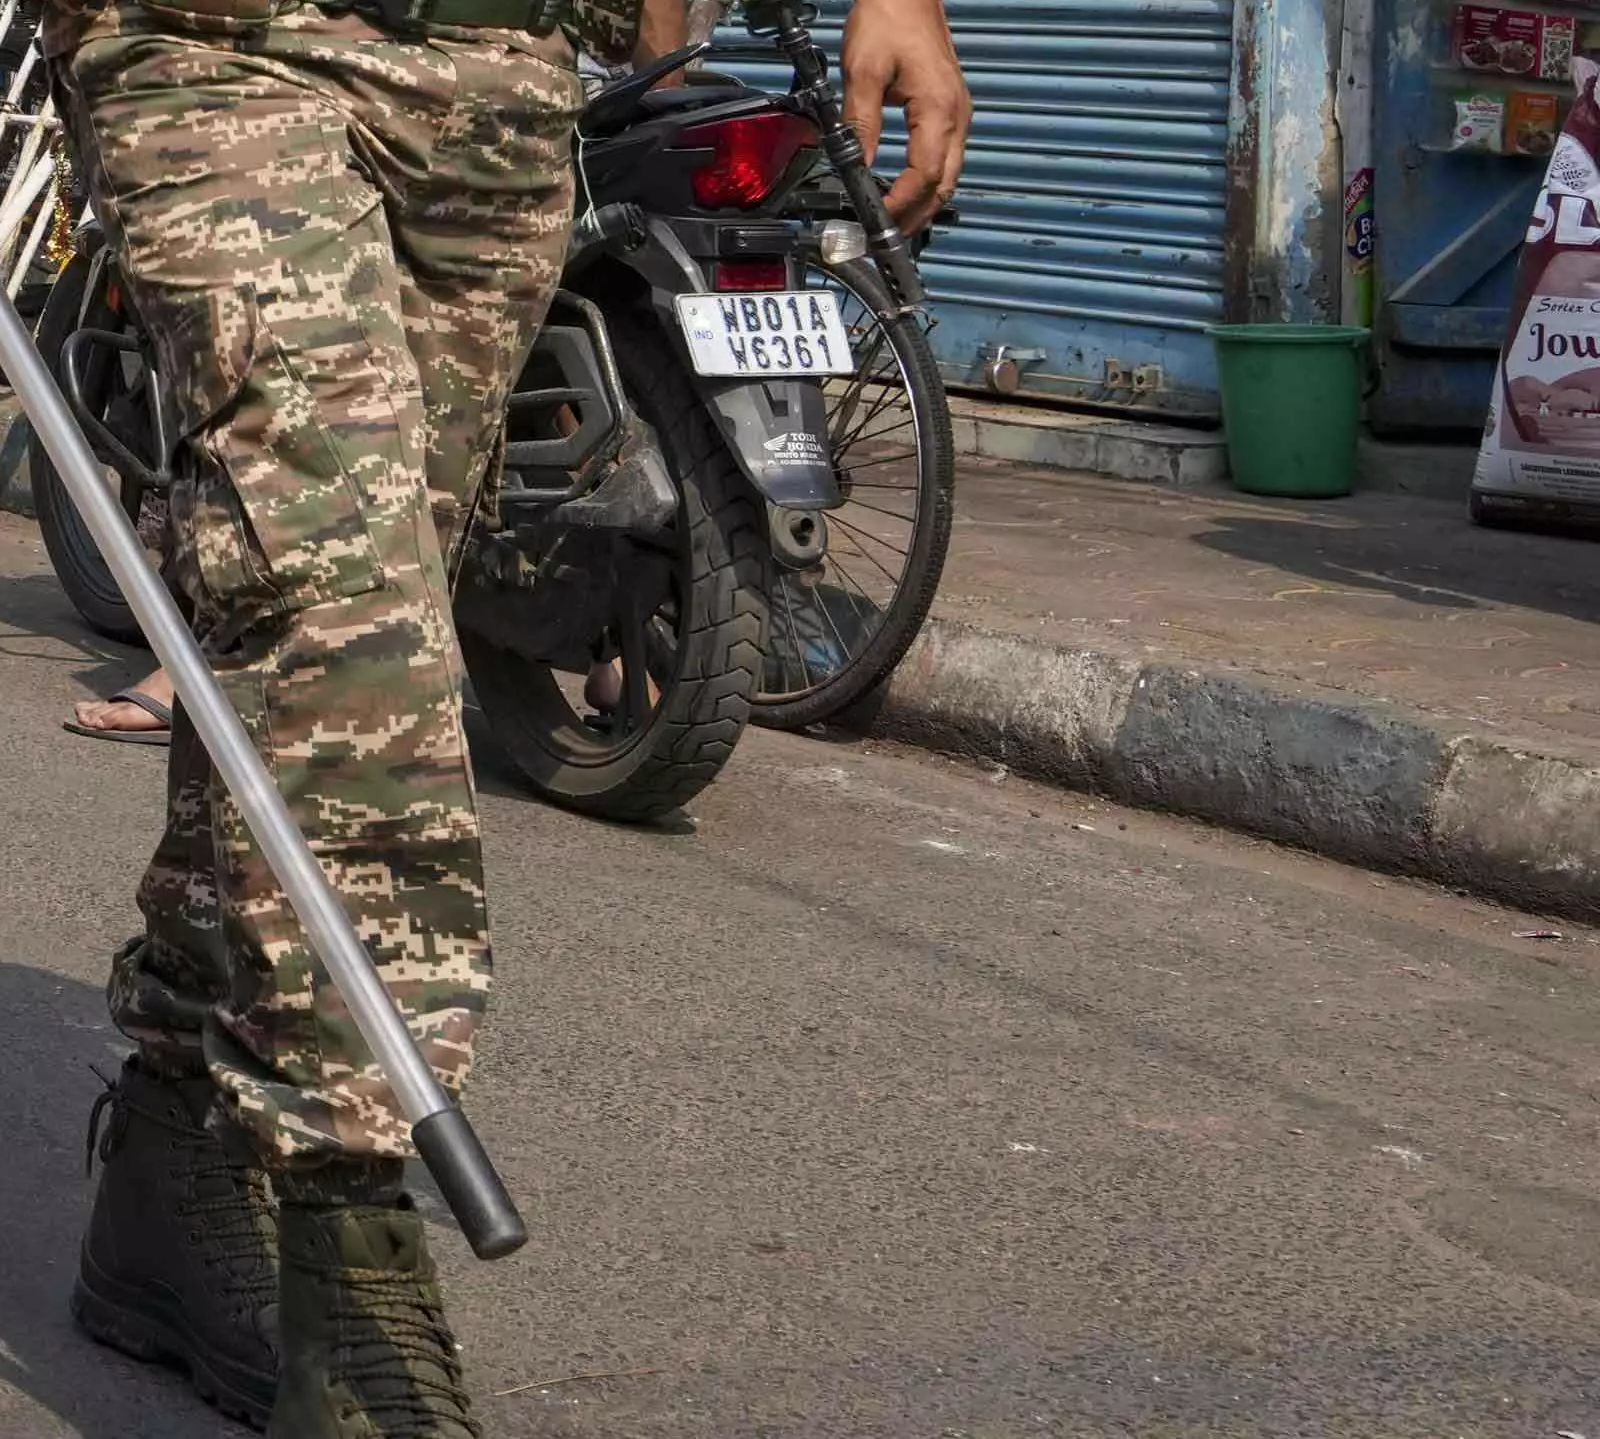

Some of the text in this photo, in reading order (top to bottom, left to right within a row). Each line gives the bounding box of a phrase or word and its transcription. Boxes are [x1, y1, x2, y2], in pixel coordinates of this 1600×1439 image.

[717, 296, 829, 333] WB01A
[1536, 297, 1584, 313] Sortex
[693, 330, 714, 341] IND
[727, 335, 834, 371] W6361
